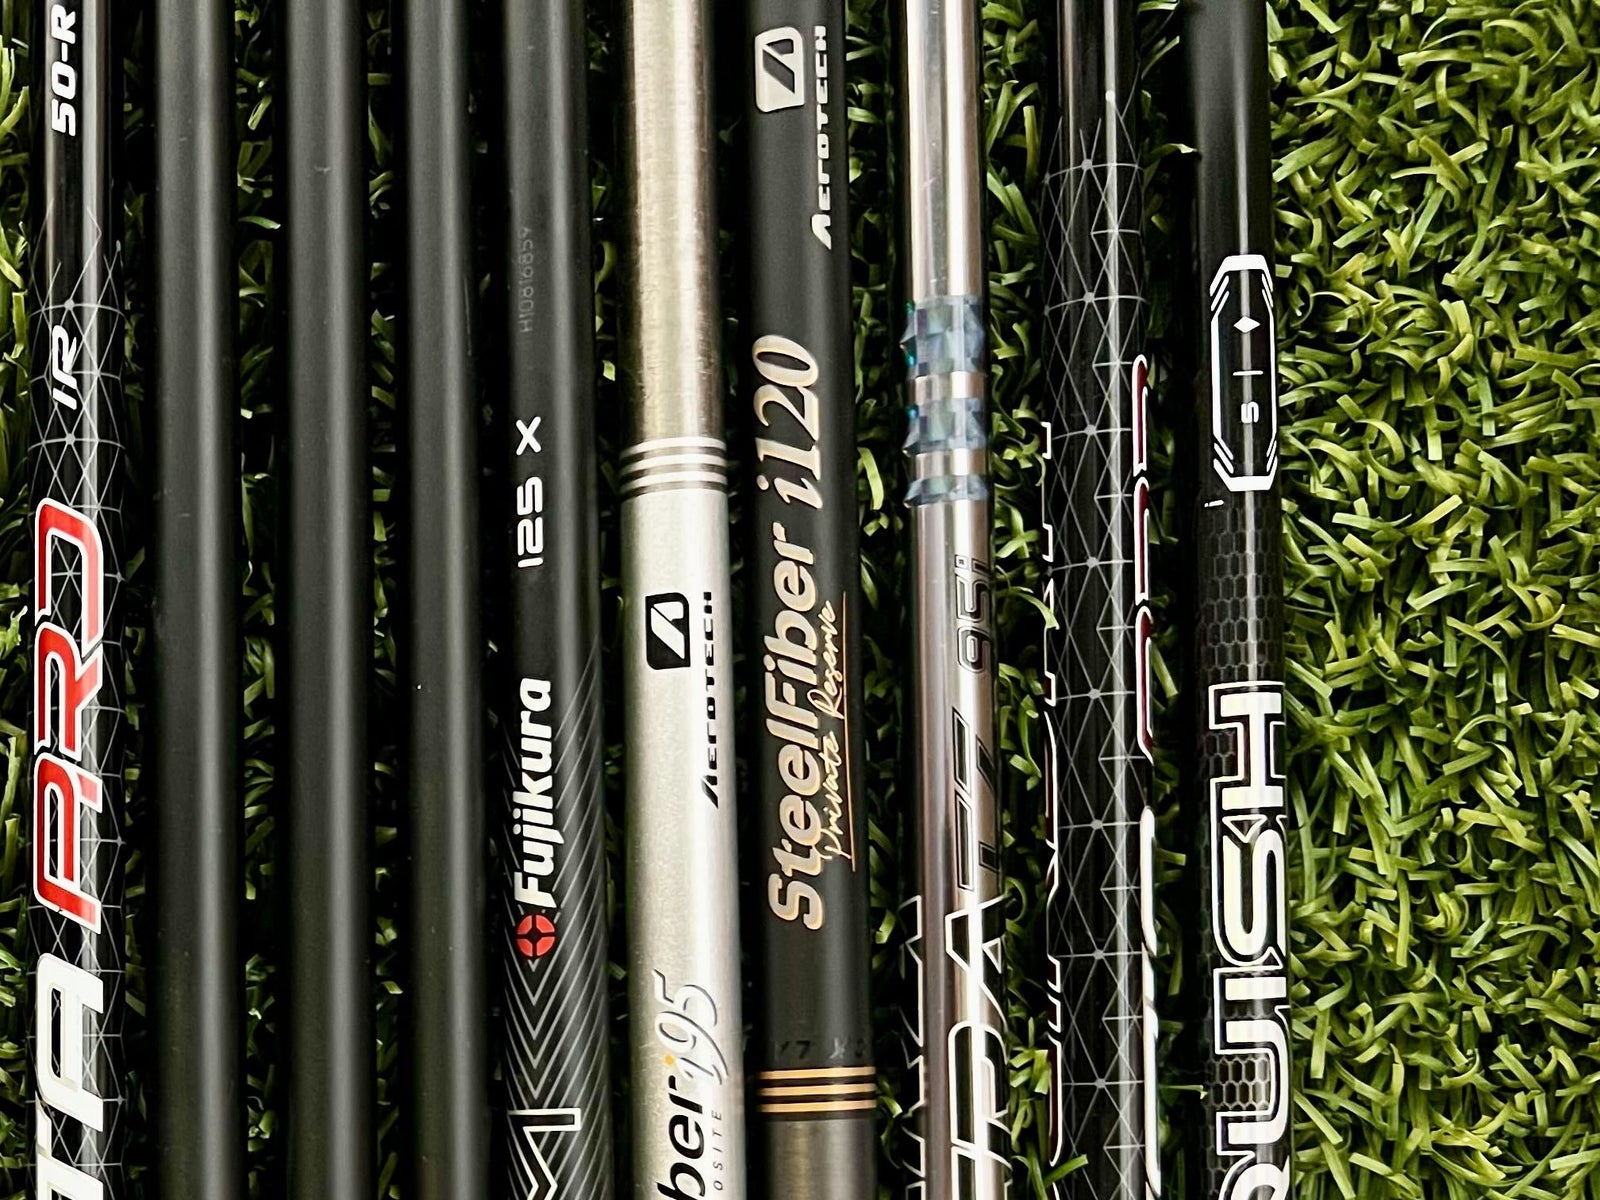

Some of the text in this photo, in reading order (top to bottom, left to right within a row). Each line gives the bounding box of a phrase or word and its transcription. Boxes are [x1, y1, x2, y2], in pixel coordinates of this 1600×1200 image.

[51, 4, 78, 136] 50-R
[516, 416, 543, 568] 125 X
[751, 333, 824, 931] SteelFiber i120
[513, 676, 564, 909] Fujikura
[807, 598, 851, 860] Private Reserve
[651, 969, 728, 1084] i95
